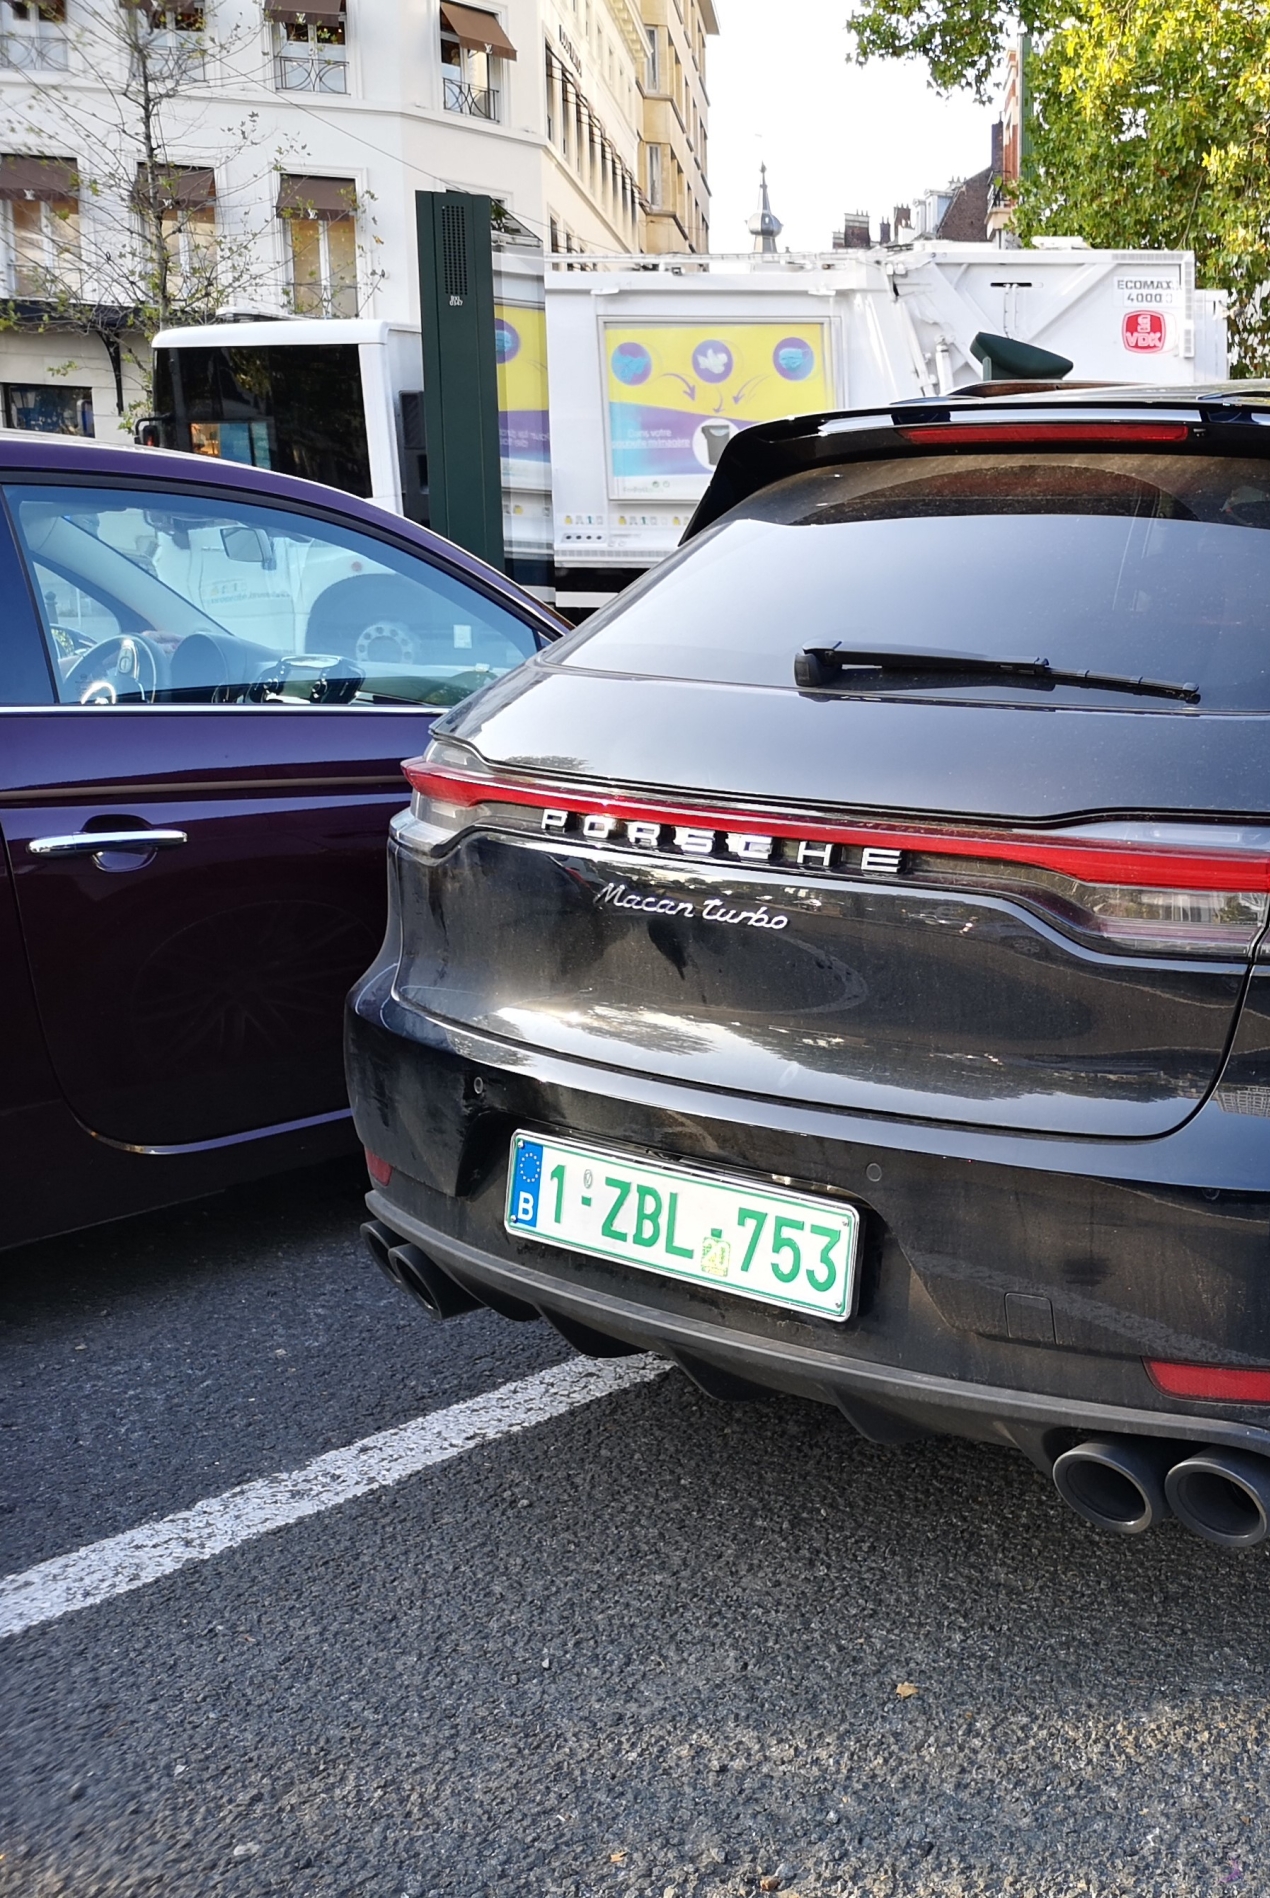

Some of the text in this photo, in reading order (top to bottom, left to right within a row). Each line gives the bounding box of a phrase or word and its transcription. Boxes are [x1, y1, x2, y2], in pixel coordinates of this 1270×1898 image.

[1117, 280, 1172, 290] ECOMAX
[1126, 331, 1161, 347] VDK
[540, 808, 904, 874] PORSCHE
[593, 881, 790, 931] Macan turbo
